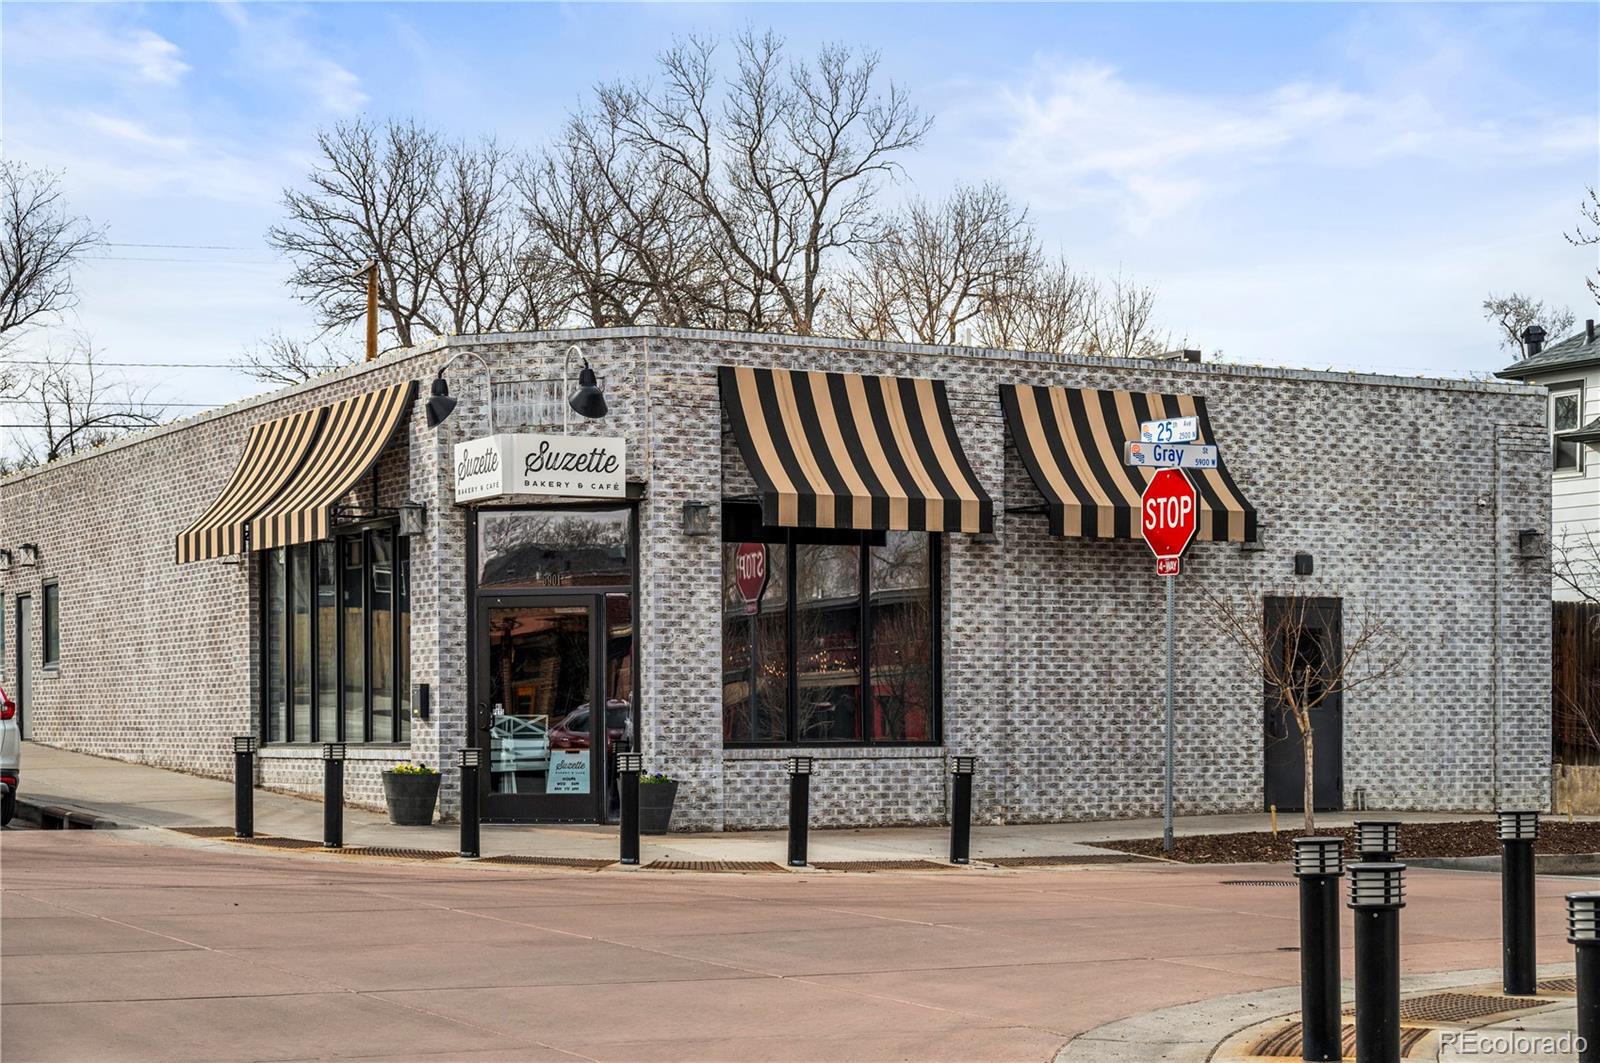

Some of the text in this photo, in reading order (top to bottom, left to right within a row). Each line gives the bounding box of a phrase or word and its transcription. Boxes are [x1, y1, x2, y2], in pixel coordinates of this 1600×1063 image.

[524, 440, 620, 477] Suzette
[1153, 444, 1209, 466] Gray St
[458, 447, 499, 486] Suzette
[1195, 458, 1210, 466] 5900
[458, 487, 478, 496] BAKERY
[524, 480, 570, 489] BAKERY
[591, 481, 620, 491] CAFÉ
[1145, 495, 1192, 530] STOP
[1158, 560, 1178, 572] 4-WAY
[555, 760, 585, 771] Suzette
